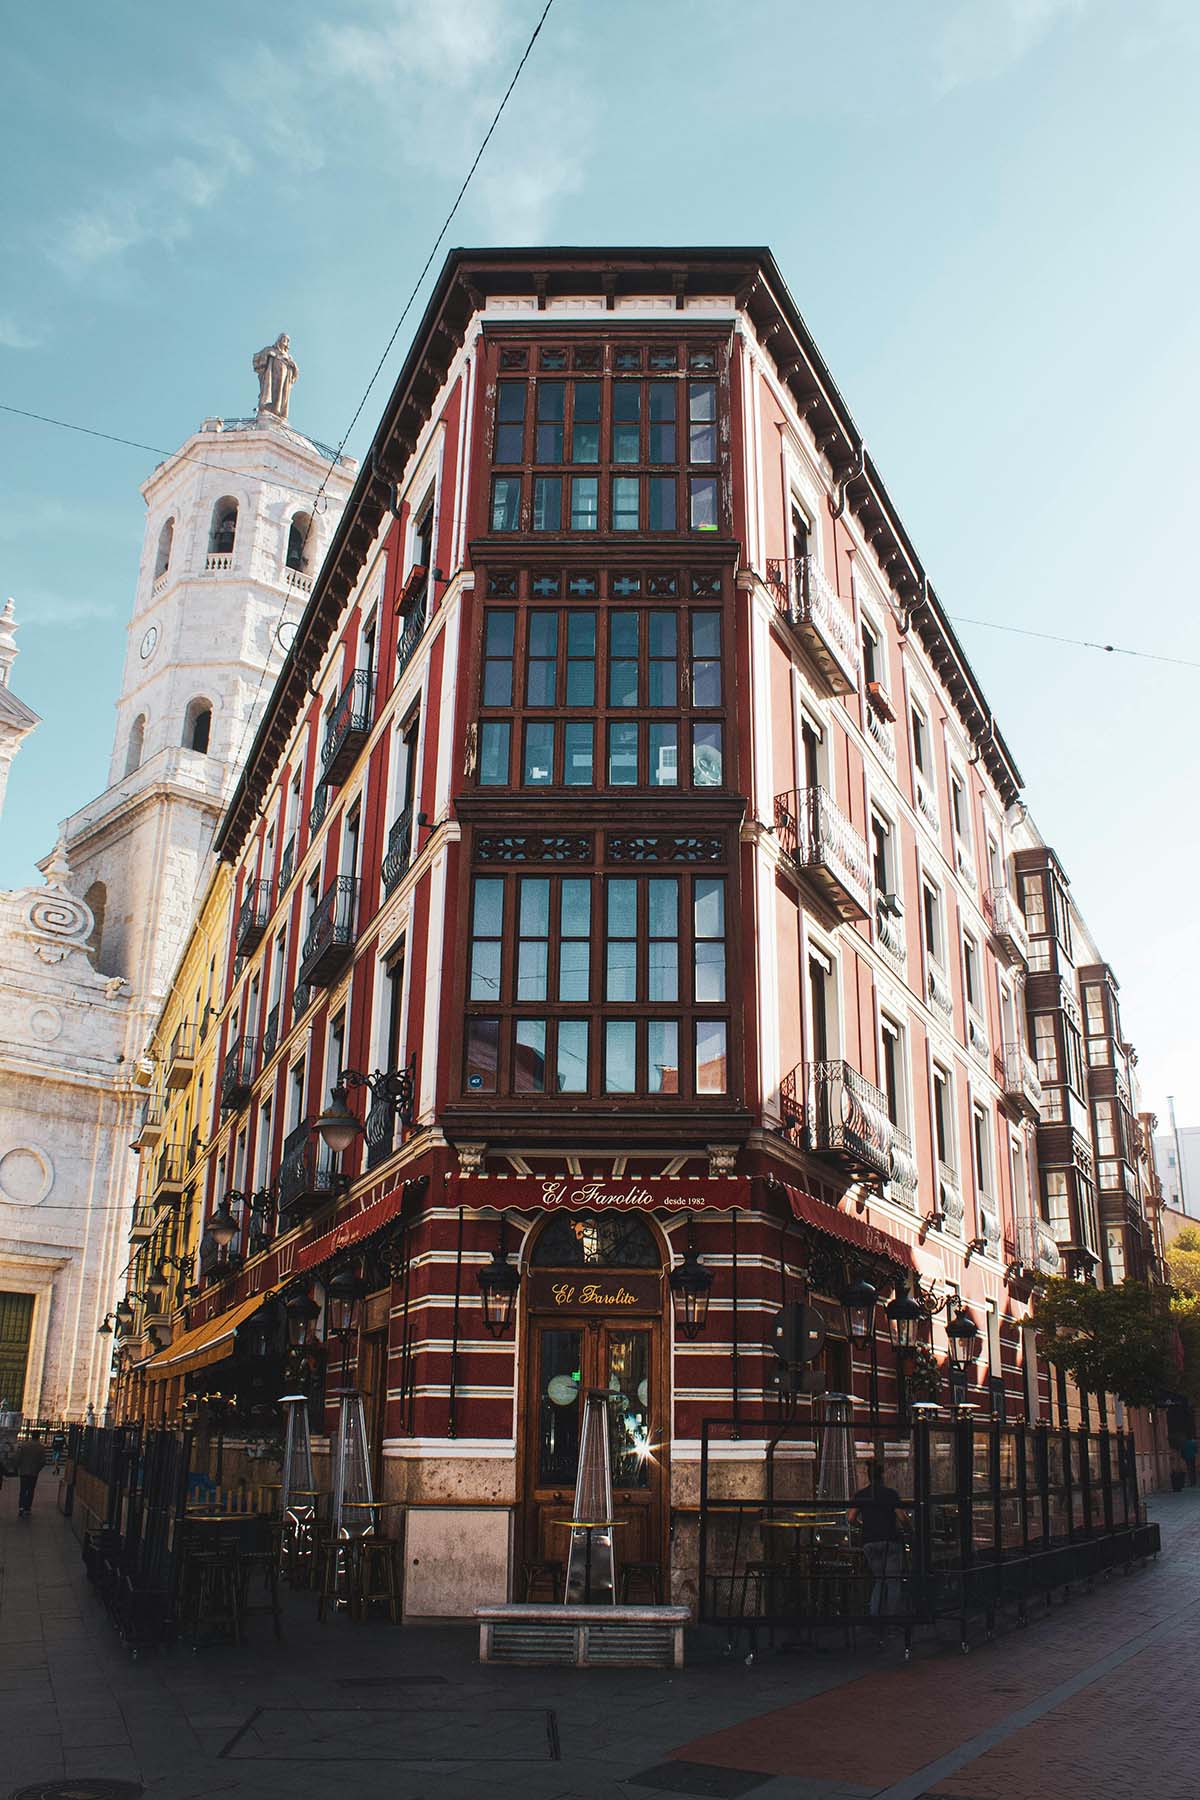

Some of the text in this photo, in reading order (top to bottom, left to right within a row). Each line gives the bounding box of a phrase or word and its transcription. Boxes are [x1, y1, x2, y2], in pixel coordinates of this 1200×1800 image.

[541, 1182, 705, 1205] El Farolito desde 1982
[552, 1283, 639, 1306] El Farolito
